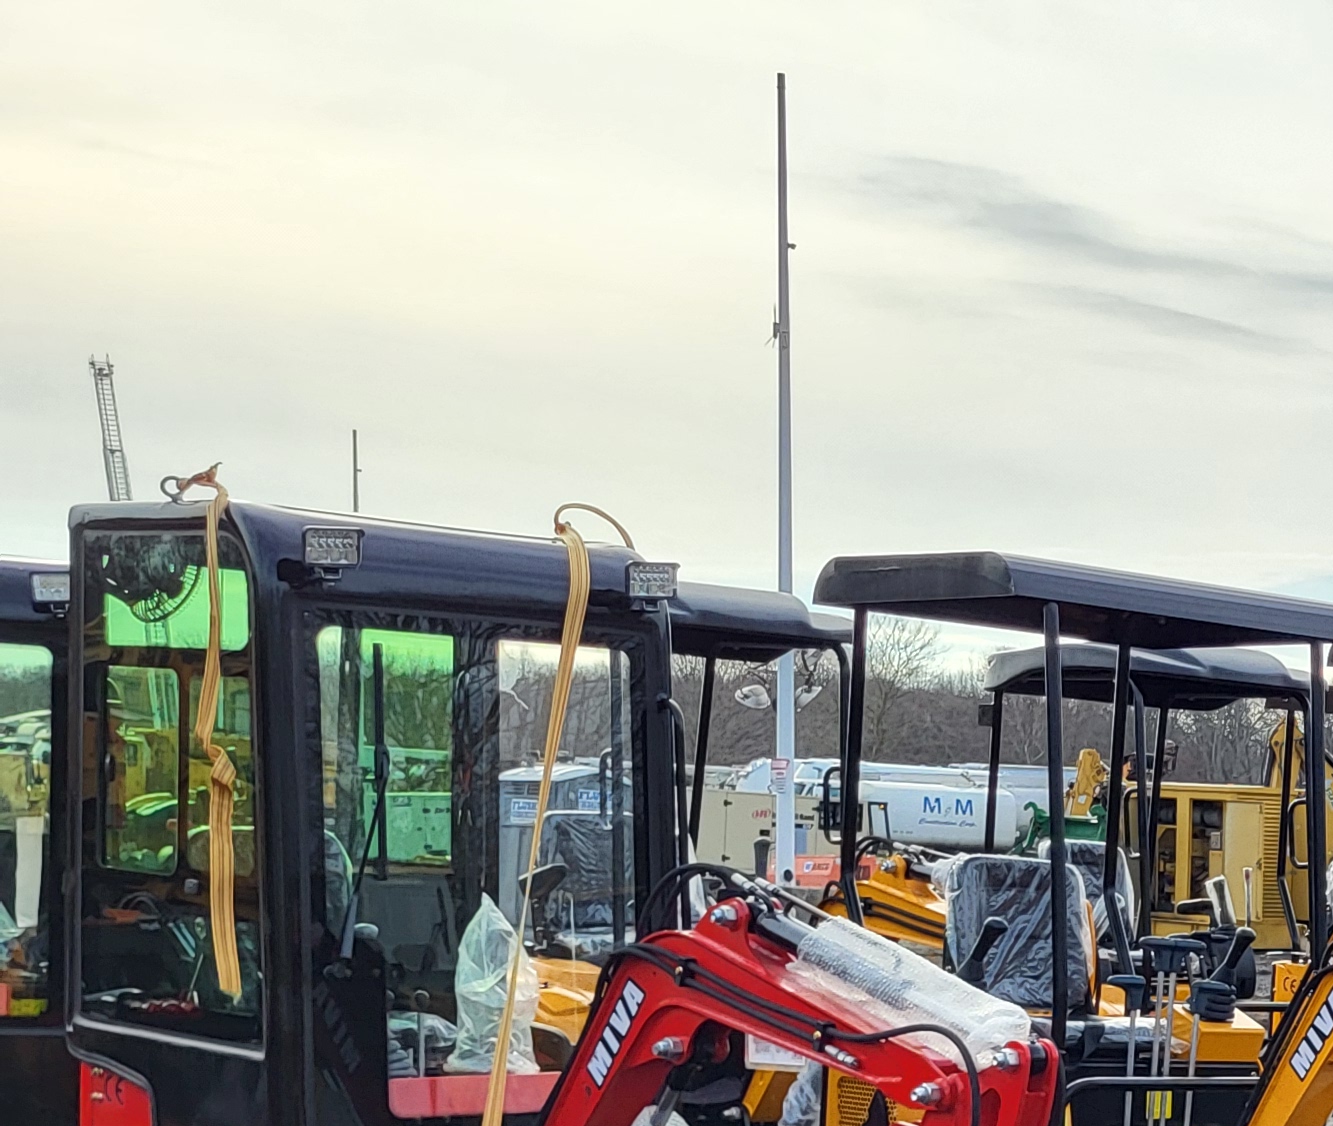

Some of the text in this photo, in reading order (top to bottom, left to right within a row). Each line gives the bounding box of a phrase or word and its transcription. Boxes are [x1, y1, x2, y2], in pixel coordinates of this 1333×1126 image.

[923, 796, 941, 814] M
[954, 798, 973, 816] M
[586, 979, 646, 1089] MIVA
